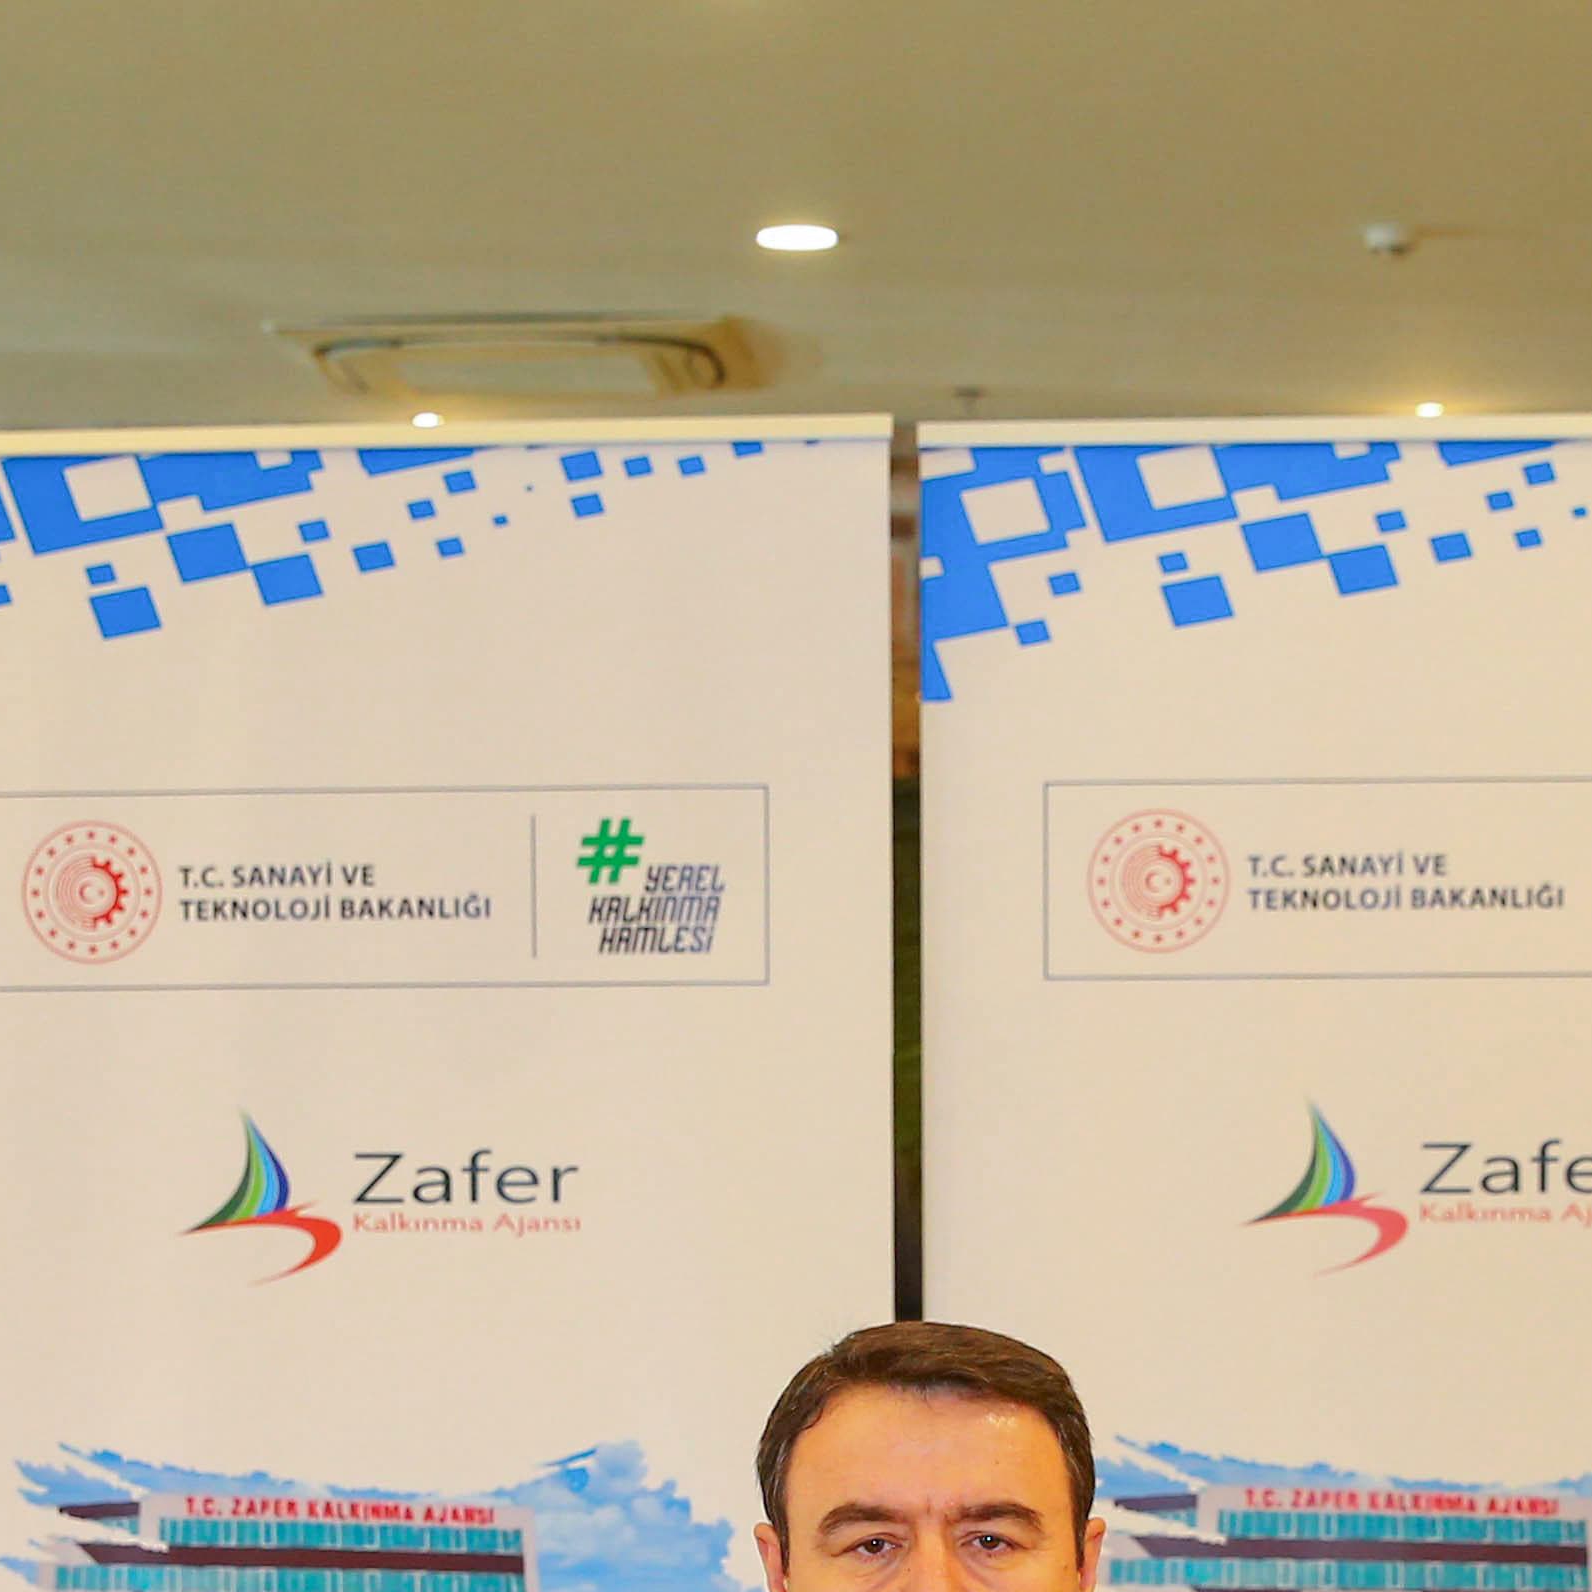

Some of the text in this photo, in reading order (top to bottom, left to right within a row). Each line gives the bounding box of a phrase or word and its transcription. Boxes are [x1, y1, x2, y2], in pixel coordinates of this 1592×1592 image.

[180, 861, 375, 887] T.C. SANAYİ VE
[1248, 851, 1447, 877] T.C. SANAYİ VE
[645, 865, 726, 892] YEREL
[180, 892, 491, 921] TEKNOLOJİ BAKANLIĞI
[589, 895, 721, 923] KALKINMA
[1249, 882, 1564, 910] TEKNOLOJİ BAKANLIĞI
[598, 926, 715, 954] HAMLESİ
[353, 1149, 579, 1204] Zafer
[353, 1212, 581, 1238] Kalkınma Ajansı
[1420, 1202, 1552, 1222] Kalkınma
[186, 1497, 495, 1525] T.C. ZAFER KALKINMA AJANSI
[1245, 1487, 1282, 1508] T.C.
[1291, 1488, 1360, 1509] ZAFER
[1368, 1490, 1476, 1513] KALKINMA
